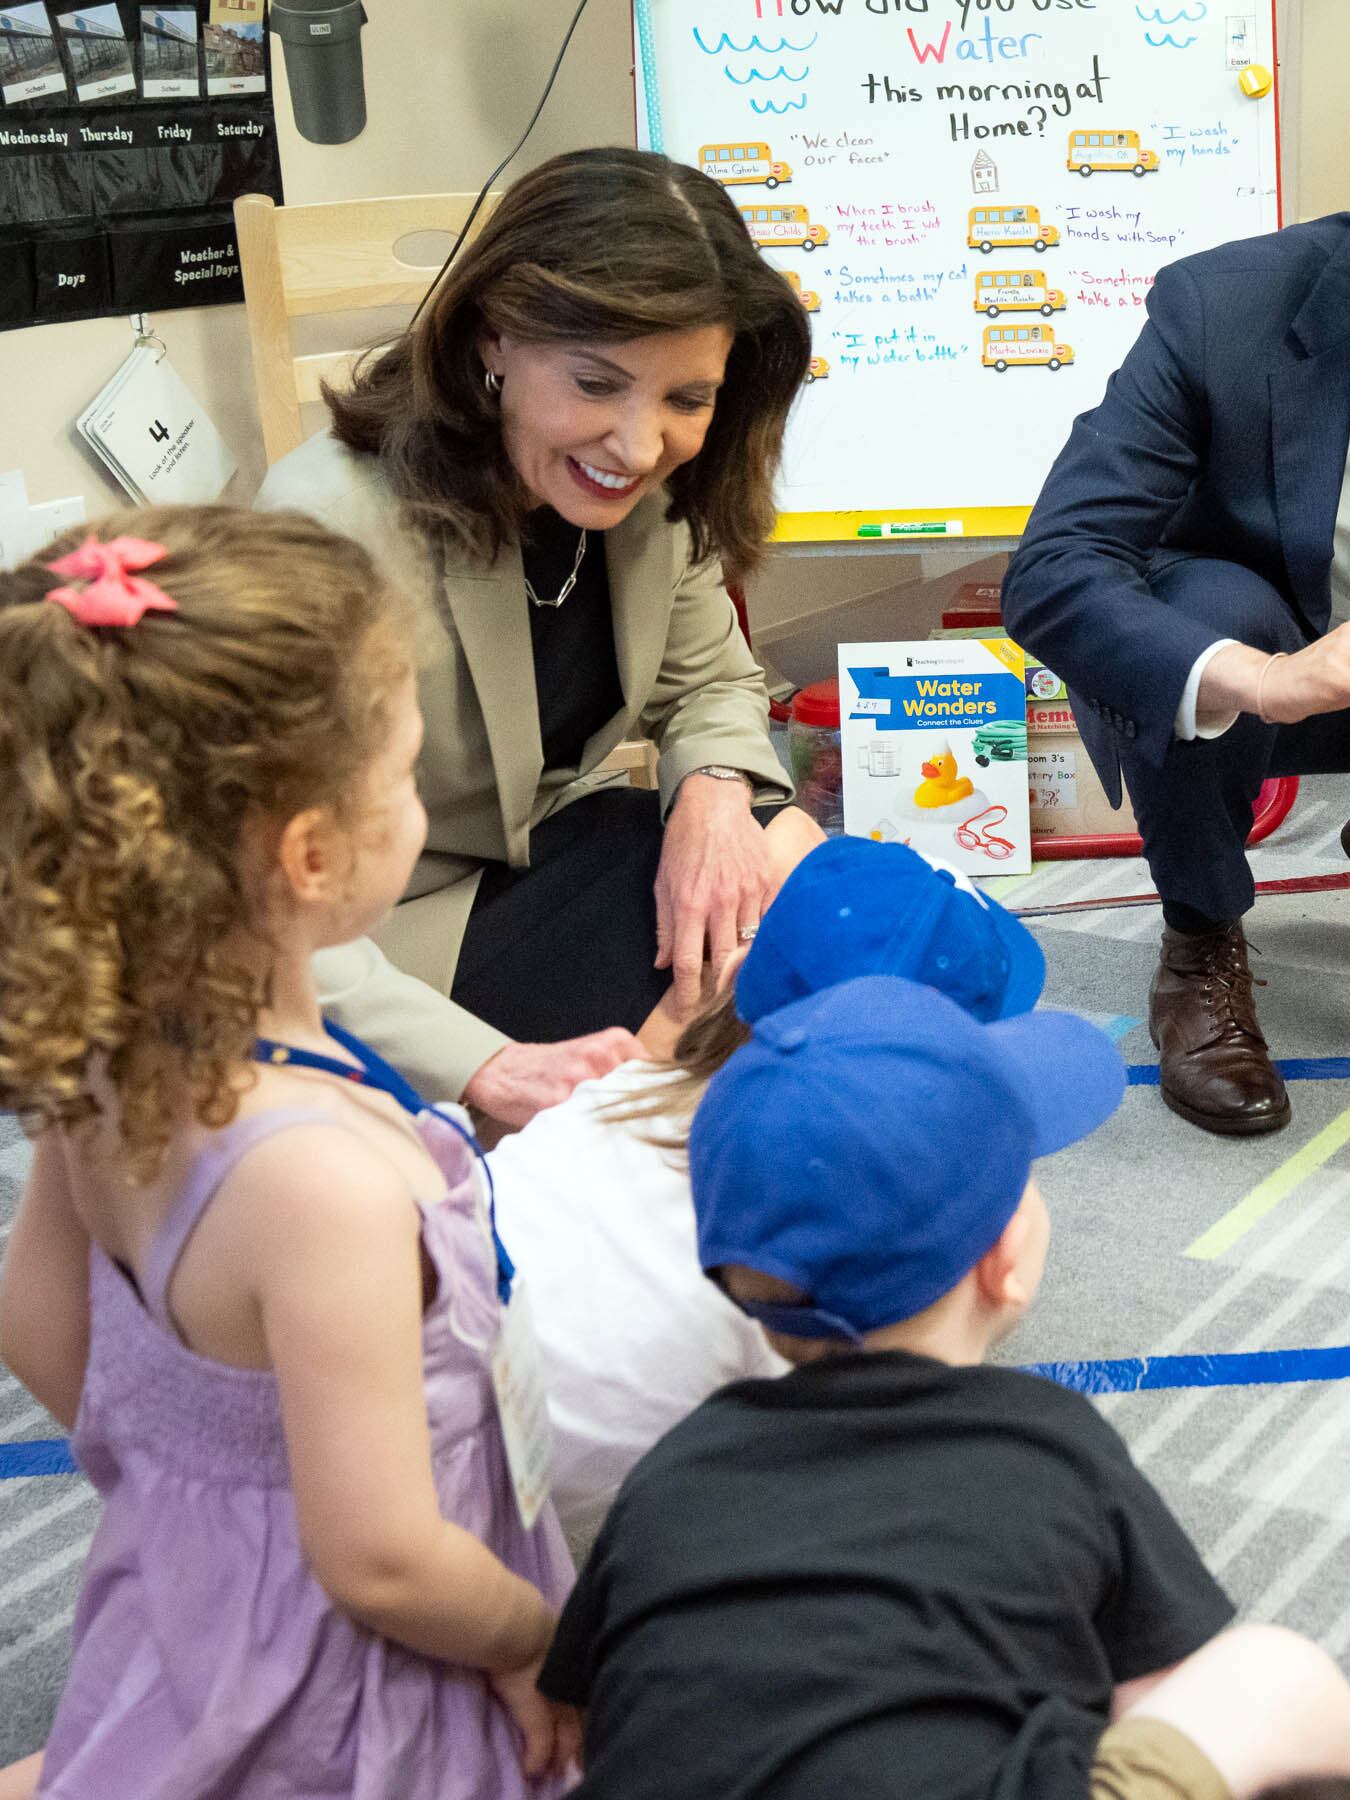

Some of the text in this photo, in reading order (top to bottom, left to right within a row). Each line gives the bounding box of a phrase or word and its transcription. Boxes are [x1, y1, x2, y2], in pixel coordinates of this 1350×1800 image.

[954, 0, 1015, 32] you
[907, 16, 1043, 64] Water
[160, 85, 182, 93] School
[861, 54, 1111, 117] this morning at
[217, 121, 264, 138] Saturday
[949, 105, 1048, 142] Home?
[1190, 121, 1229, 137] wash
[0, 128, 69, 146] Wednesday
[80, 126, 134, 144] Thursday
[157, 124, 193, 142] Friday
[836, 132, 874, 148] clean
[1166, 147, 1186, 166] my
[880, 204, 895, 215] I
[897, 200, 936, 215] brush
[1086, 206, 1122, 220] wash
[1125, 211, 1142, 228] my
[836, 222, 856, 238] my
[860, 218, 897, 231] teeth
[901, 219, 916, 231] I
[1066, 226, 1110, 242] hands
[1117, 230, 1145, 242] with
[857, 232, 876, 246] the
[180, 244, 235, 264] Weather &
[57, 273, 87, 289] Days
[174, 262, 240, 286] Special Days
[923, 271, 945, 289] my
[948, 263, 968, 280] cat
[834, 290, 874, 304] takes
[881, 292, 893, 304] a
[1077, 289, 1111, 307] take
[1118, 296, 1128, 306] a
[874, 327, 900, 347] put
[905, 326, 918, 344] it
[923, 333, 936, 343] in
[840, 353, 860, 373] my
[149, 419, 170, 442] 4
[176, 419, 195, 445] speaker
[916, 679, 982, 698] Water
[902, 699, 997, 717] Wonders
[917, 720, 948, 728] Connect
[963, 718, 984, 726] Clues
[1057, 770, 1076, 780] Box
